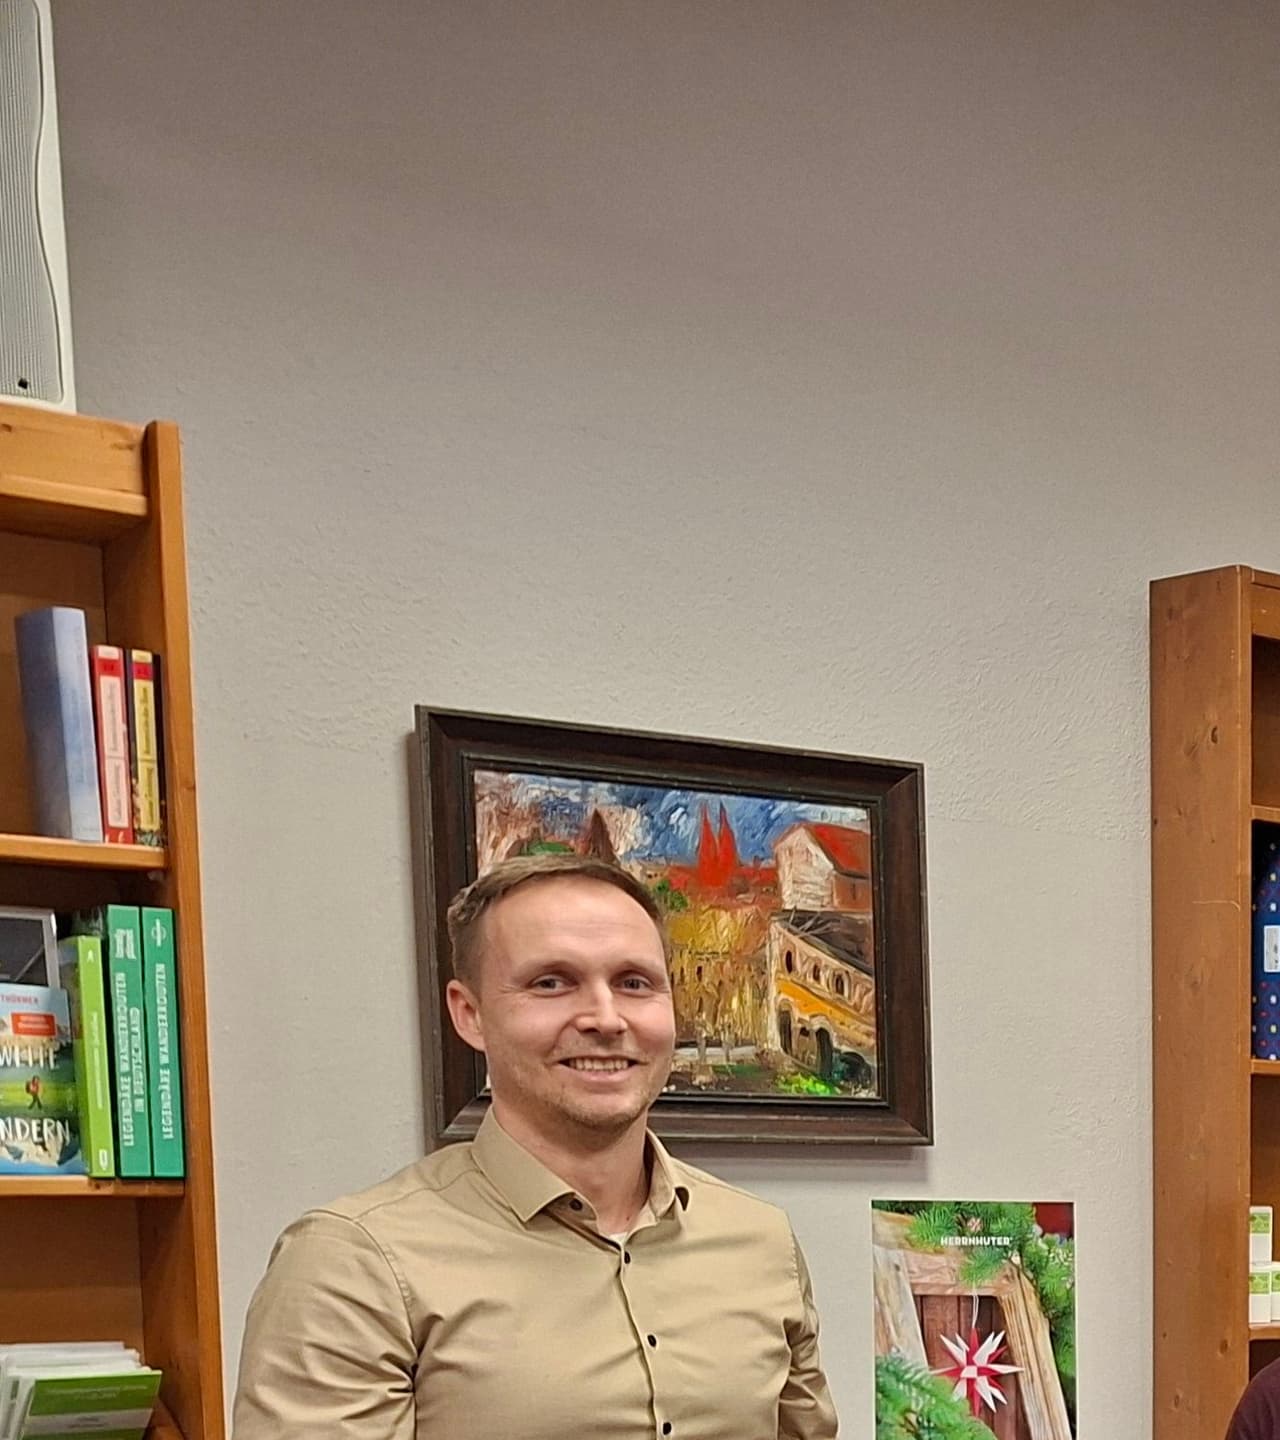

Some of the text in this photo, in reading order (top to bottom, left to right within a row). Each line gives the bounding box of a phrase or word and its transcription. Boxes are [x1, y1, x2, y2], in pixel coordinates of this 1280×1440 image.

[155, 963, 175, 1140] LEGENDÄRE WANDERROUTEN
[0, 1116, 71, 1146] NDERN
[117, 1076, 135, 1146] LEGENDÄRE
[939, 1235, 1013, 1247] HERRNHUTER
